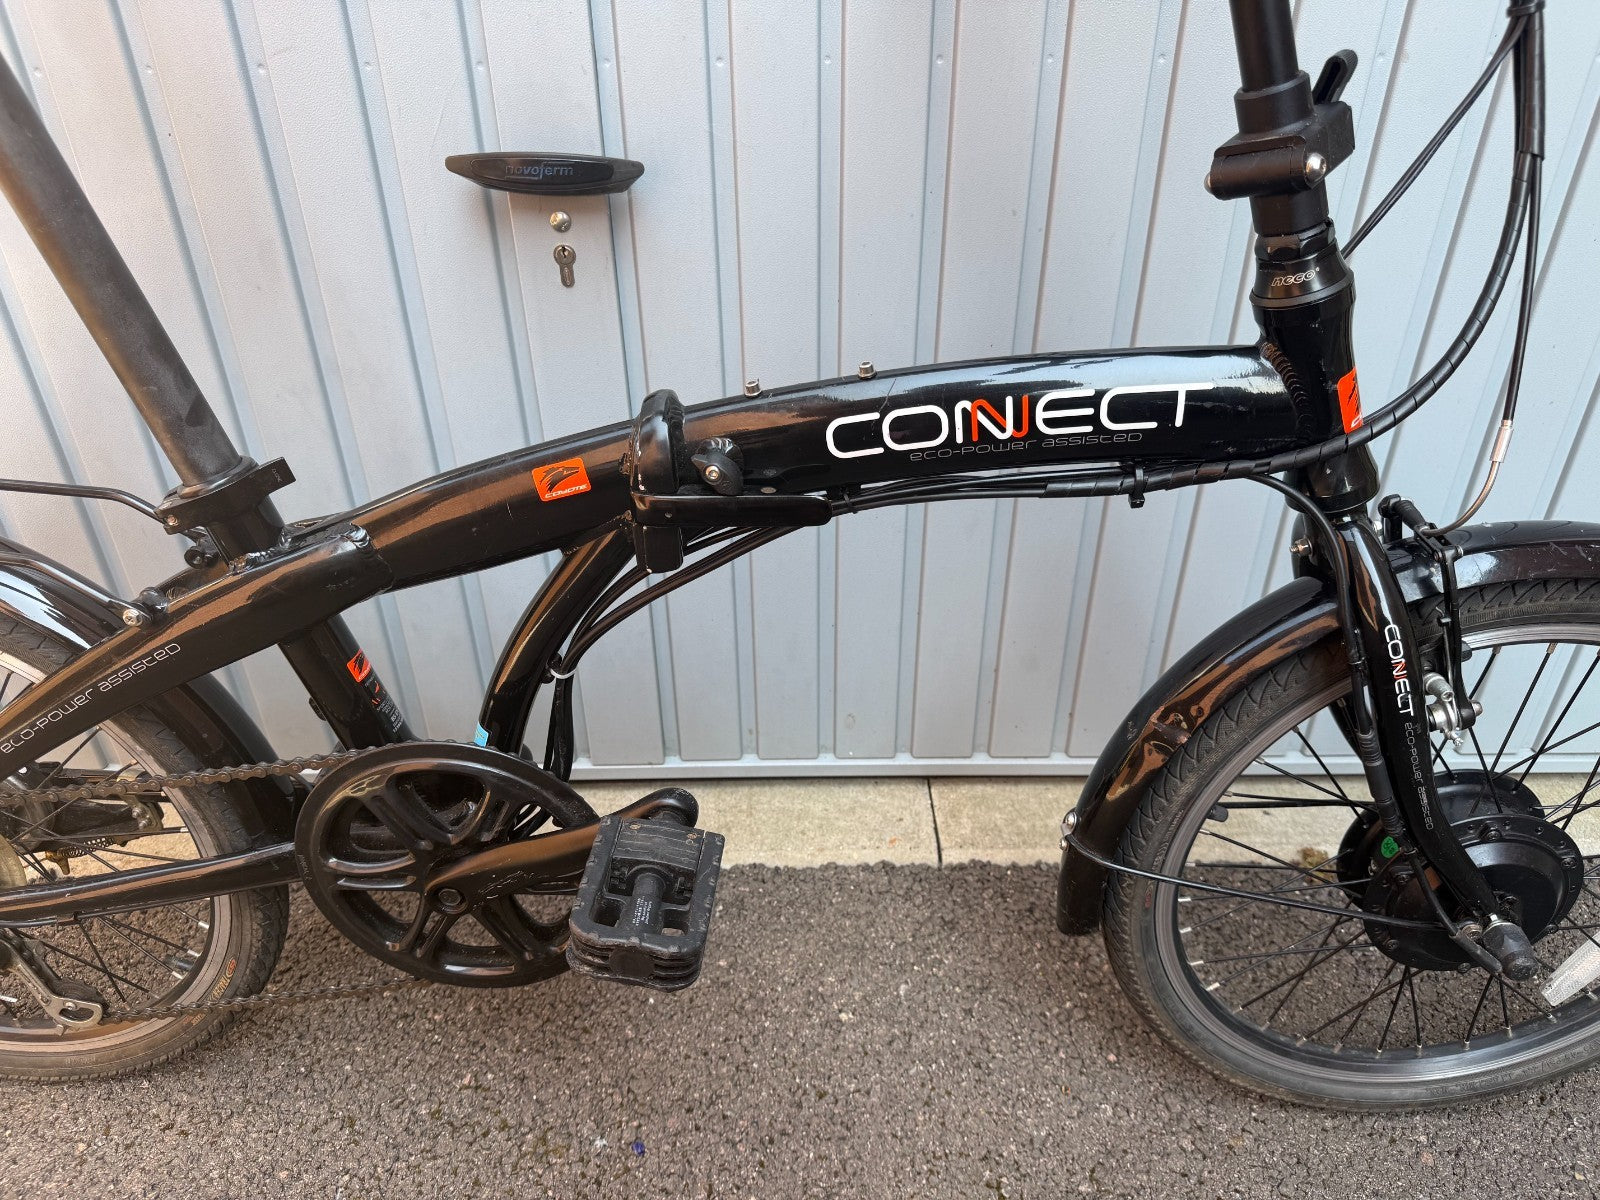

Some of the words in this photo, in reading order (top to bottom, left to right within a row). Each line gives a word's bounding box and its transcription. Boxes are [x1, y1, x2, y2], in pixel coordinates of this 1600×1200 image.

[504, 161, 575, 180] novoferm
[825, 381, 1215, 459] CONNECT
[544, 483, 588, 499] COYOTE
[1384, 623, 1414, 717] CONNECT
